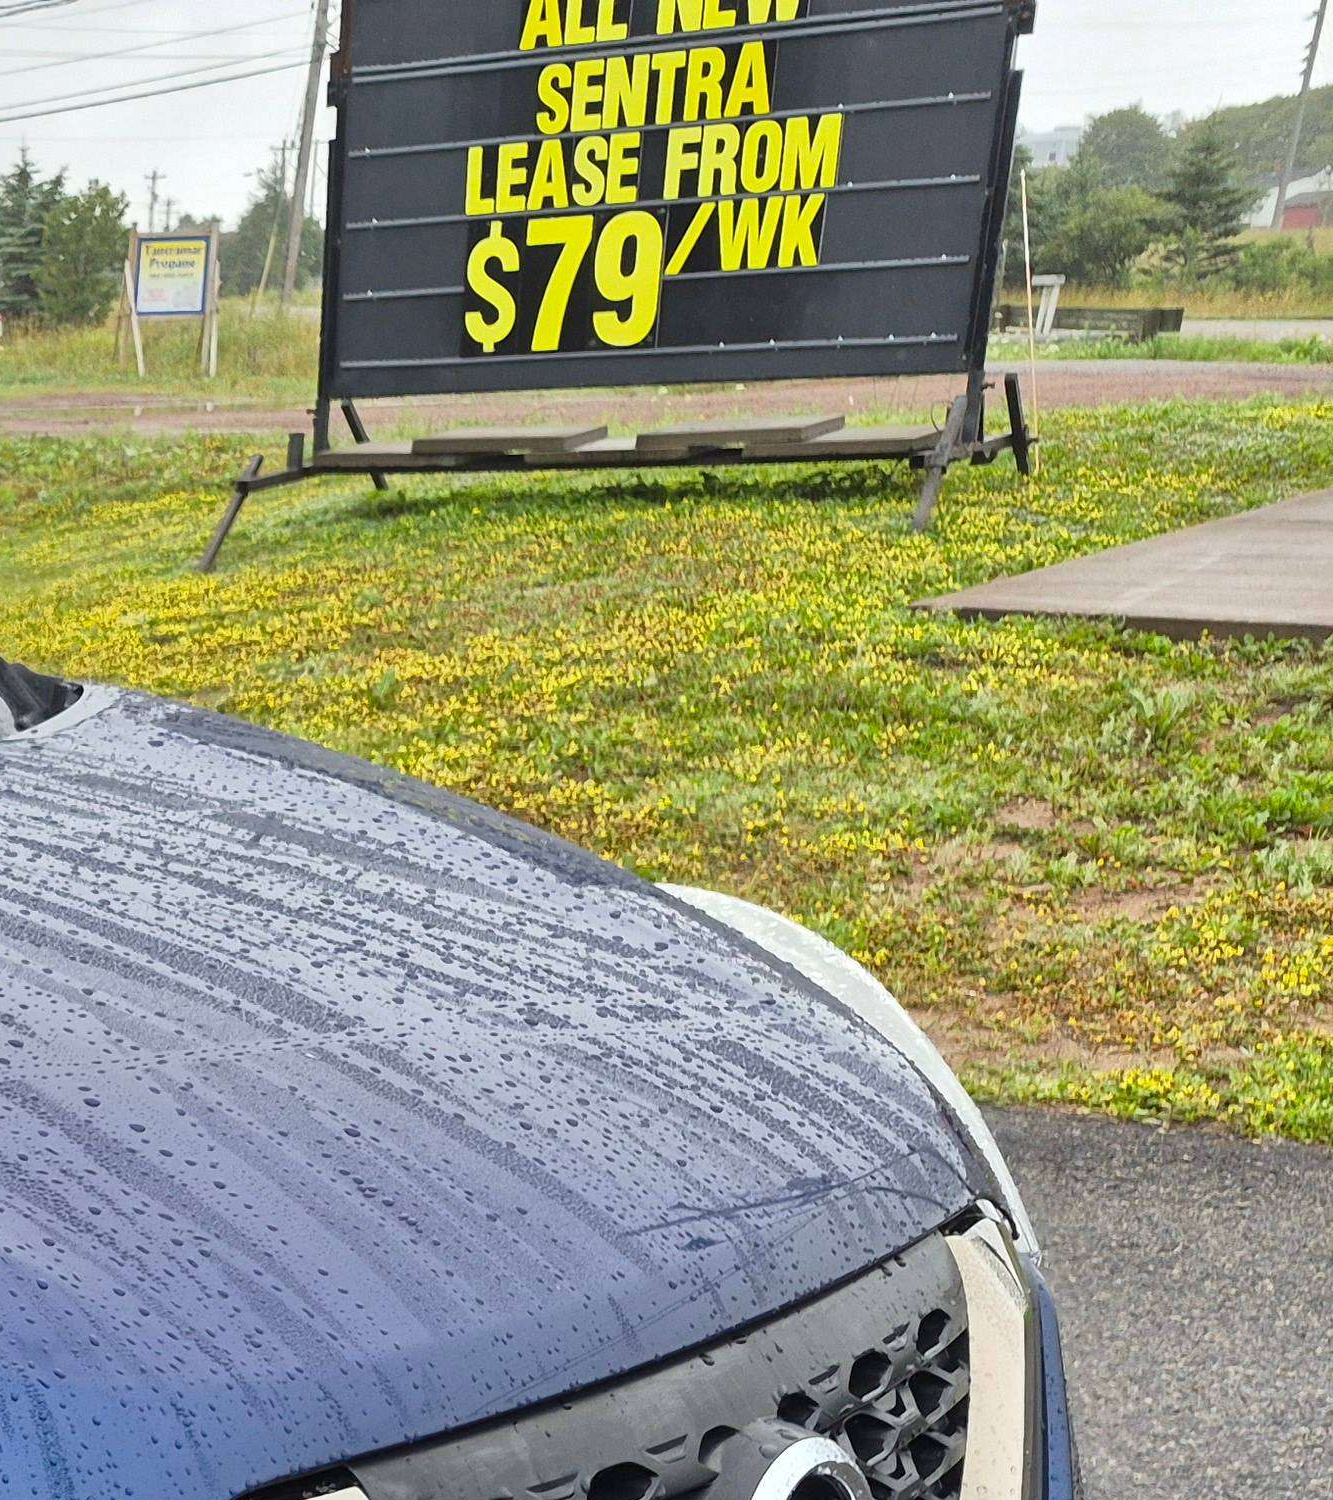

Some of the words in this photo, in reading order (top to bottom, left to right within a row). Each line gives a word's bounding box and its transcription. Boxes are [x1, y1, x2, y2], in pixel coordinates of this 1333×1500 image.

[519, 0, 628, 51] ALL
[536, 41, 771, 137] SENTRA
[465, 131, 641, 217] LEASE
[663, 113, 844, 202] FROM
